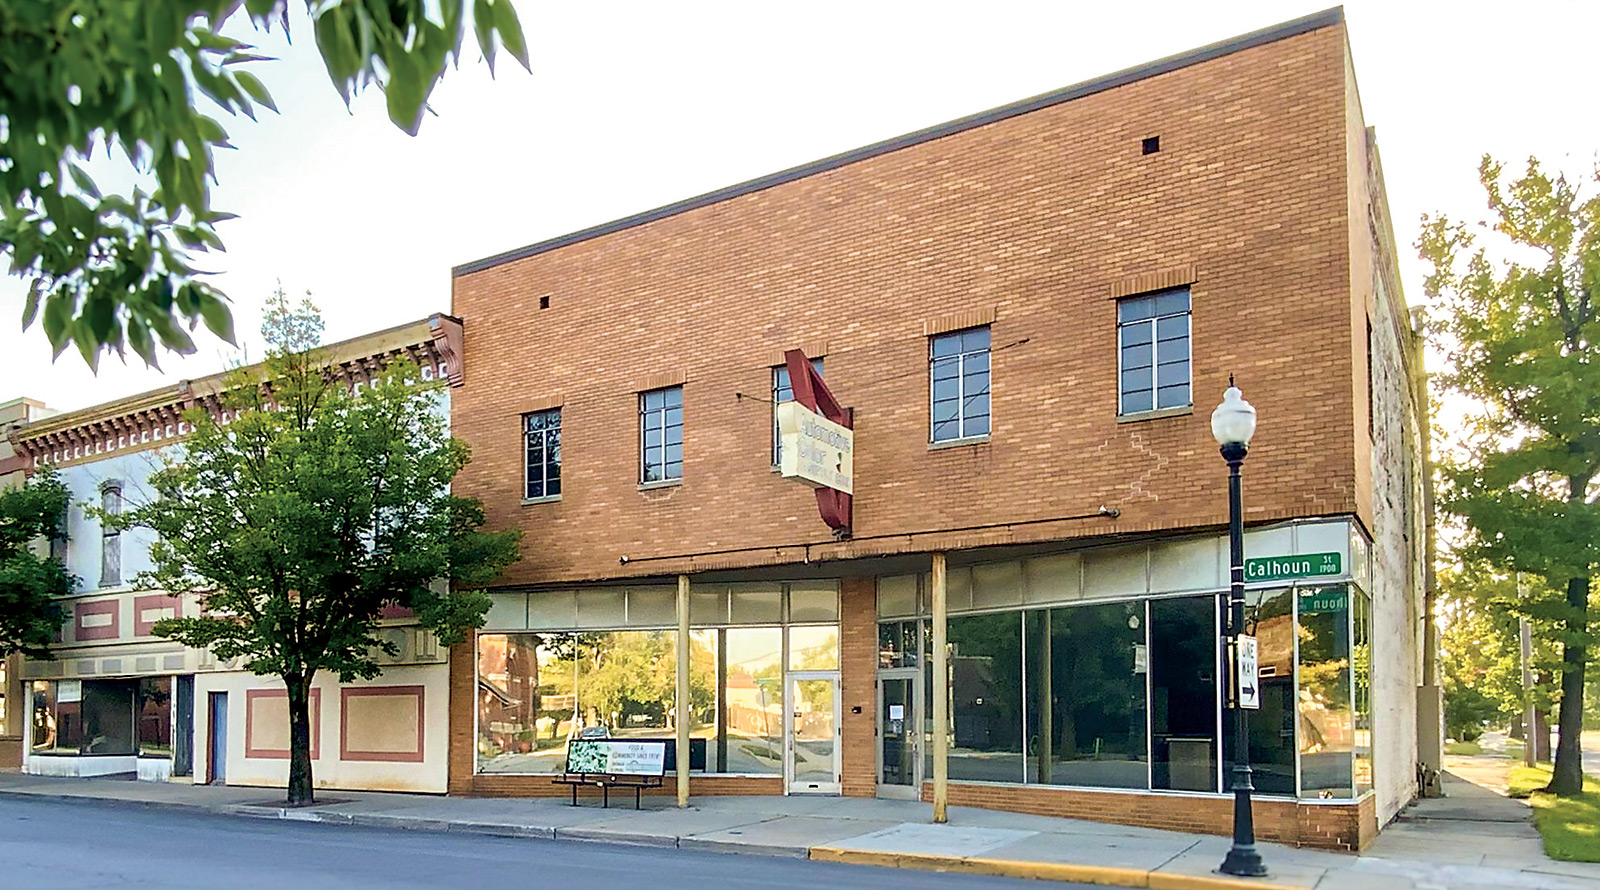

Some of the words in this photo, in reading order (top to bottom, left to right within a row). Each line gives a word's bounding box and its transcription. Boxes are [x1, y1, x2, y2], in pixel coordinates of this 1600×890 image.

[1248, 559, 1311, 577] Calhoun
[1323, 555, 1332, 564] St
[1319, 563, 1336, 573] 1900
[1242, 642, 1254, 659] ONE
[1242, 661, 1254, 677] WAY
